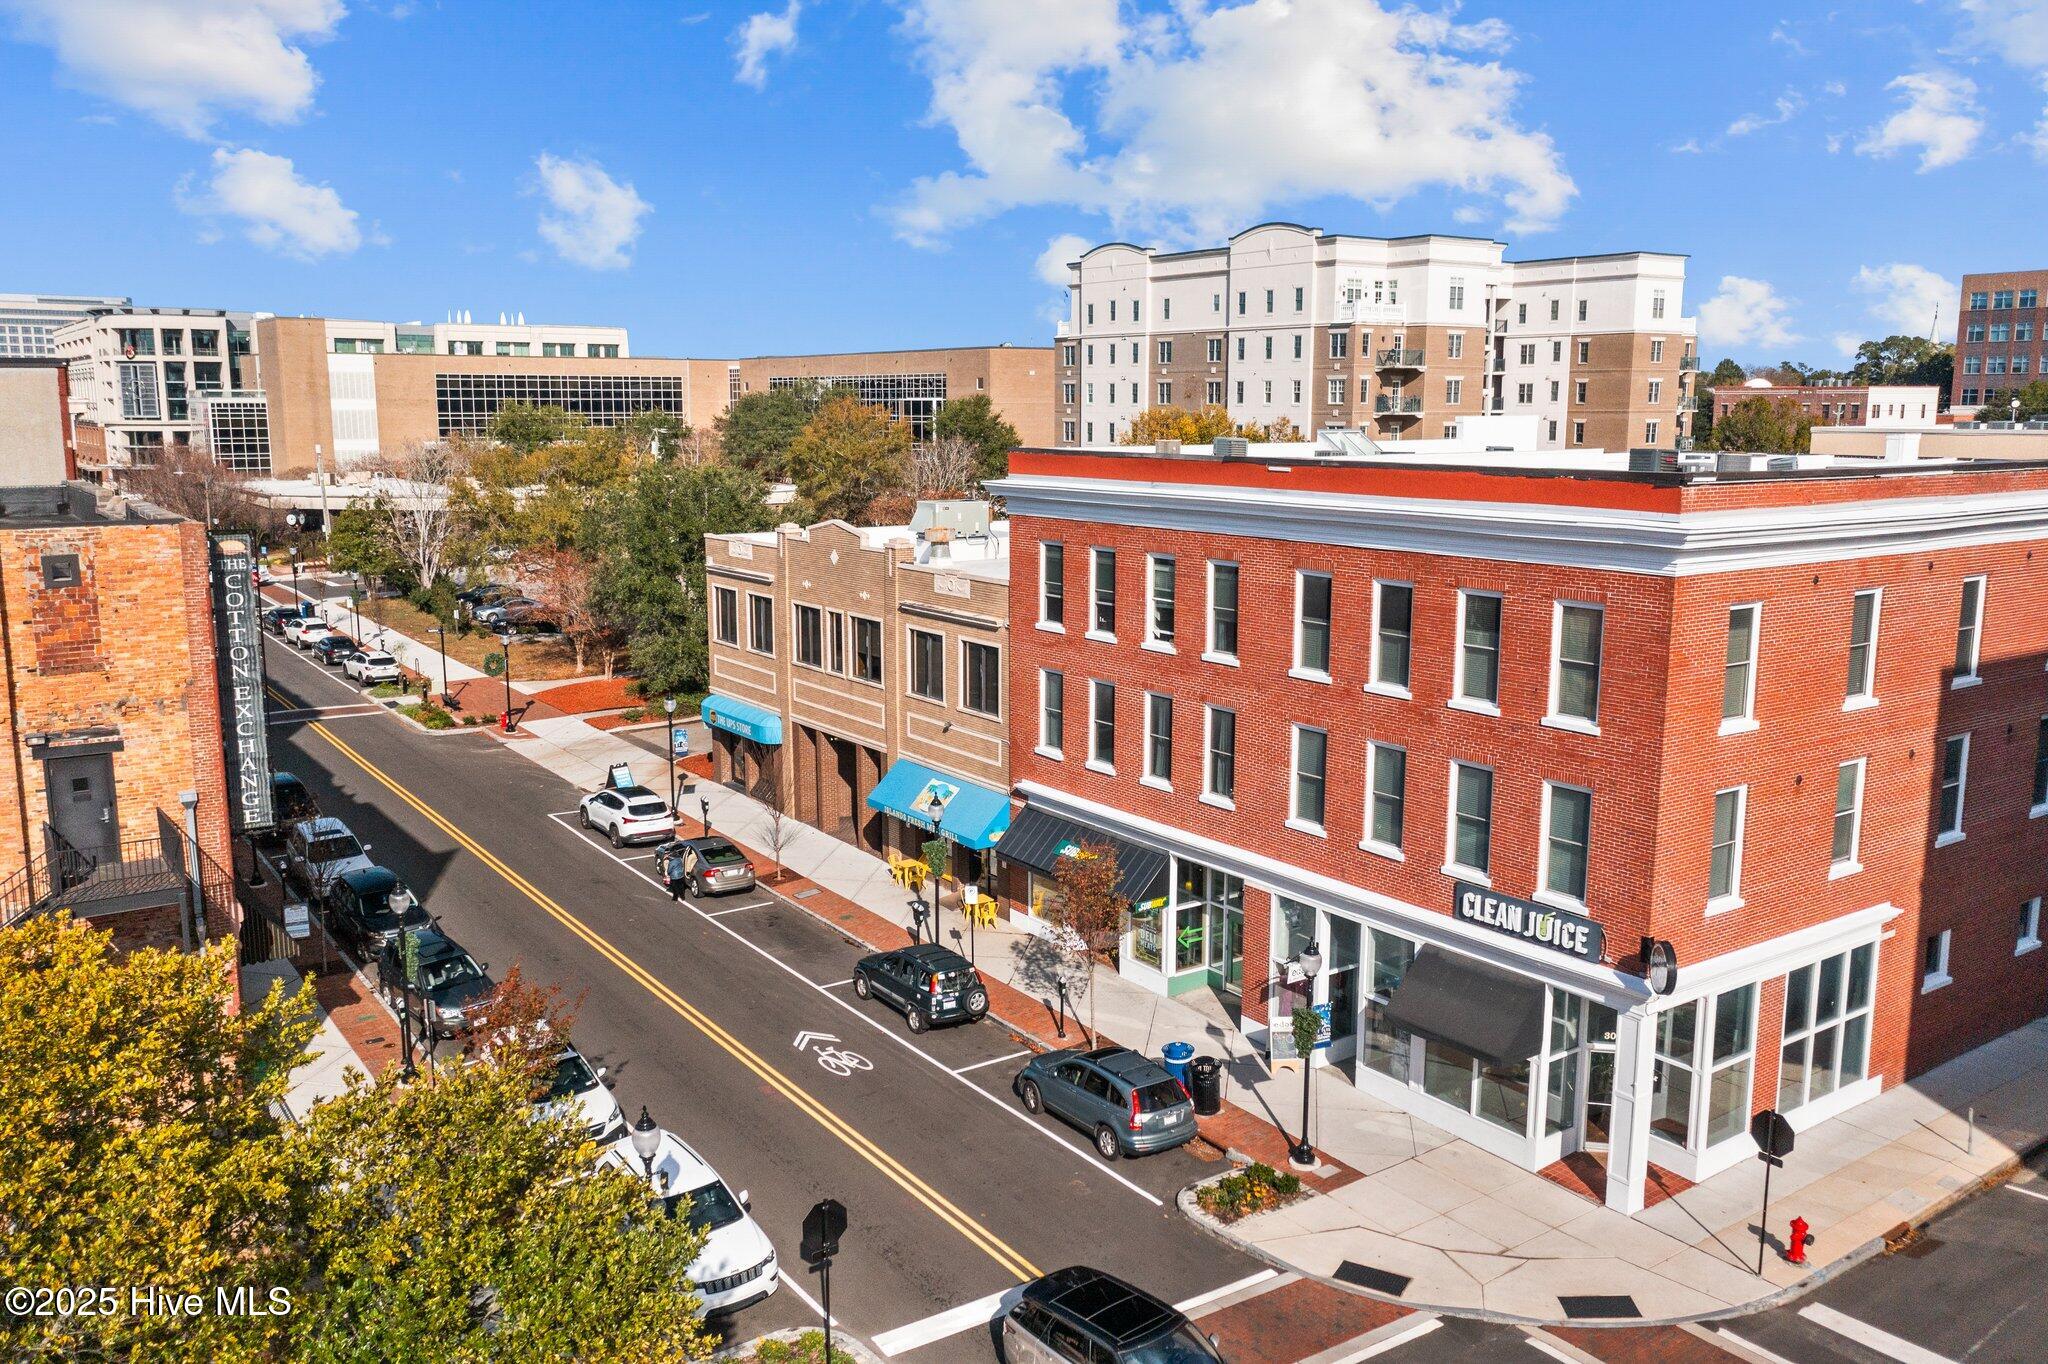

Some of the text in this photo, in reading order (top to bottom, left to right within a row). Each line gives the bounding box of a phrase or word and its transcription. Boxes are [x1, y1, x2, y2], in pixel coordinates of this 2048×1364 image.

[217, 558, 247, 570] THE
[225, 574, 250, 679] COTTON
[717, 714, 752, 736] THE UPS STORE
[234, 686, 261, 823] EXCHANGE
[1138, 897, 1167, 912] SUBWAY
[1462, 892, 1590, 954] CLEAN JUICE
[1139, 928, 1156, 944] DELI
